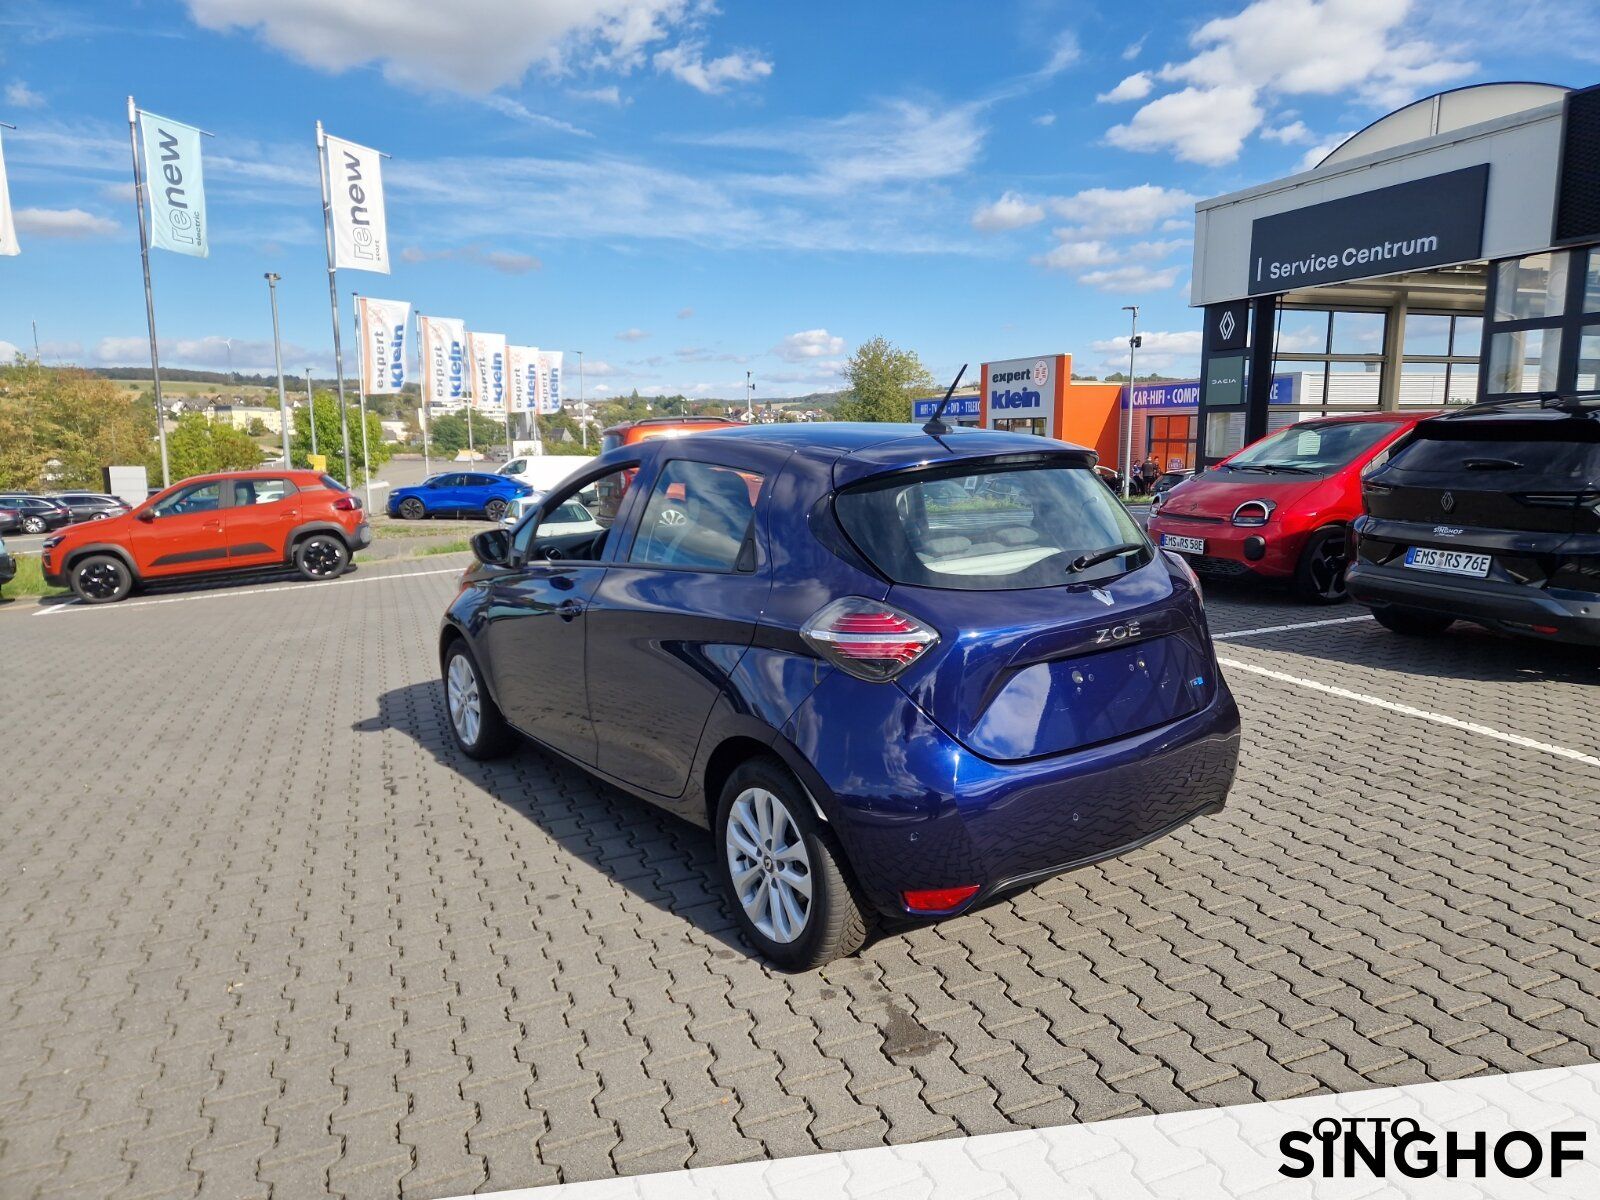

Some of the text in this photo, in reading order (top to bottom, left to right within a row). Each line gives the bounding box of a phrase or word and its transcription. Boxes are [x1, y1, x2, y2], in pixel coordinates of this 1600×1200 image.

[158, 127, 194, 245] renew
[343, 150, 374, 261] renew
[193, 211, 202, 247] electric
[1269, 234, 1438, 280] Service Centrum
[374, 331, 384, 389] expert
[436, 346, 444, 397] expert
[478, 357, 488, 402] expert
[992, 368, 1031, 384] expert
[514, 368, 522, 408] expert
[1133, 390, 1165, 406] CAR-HIFI
[1165, 536, 1202, 551] EMS RS 58E
[1414, 550, 1489, 572] EMS RS 76E
